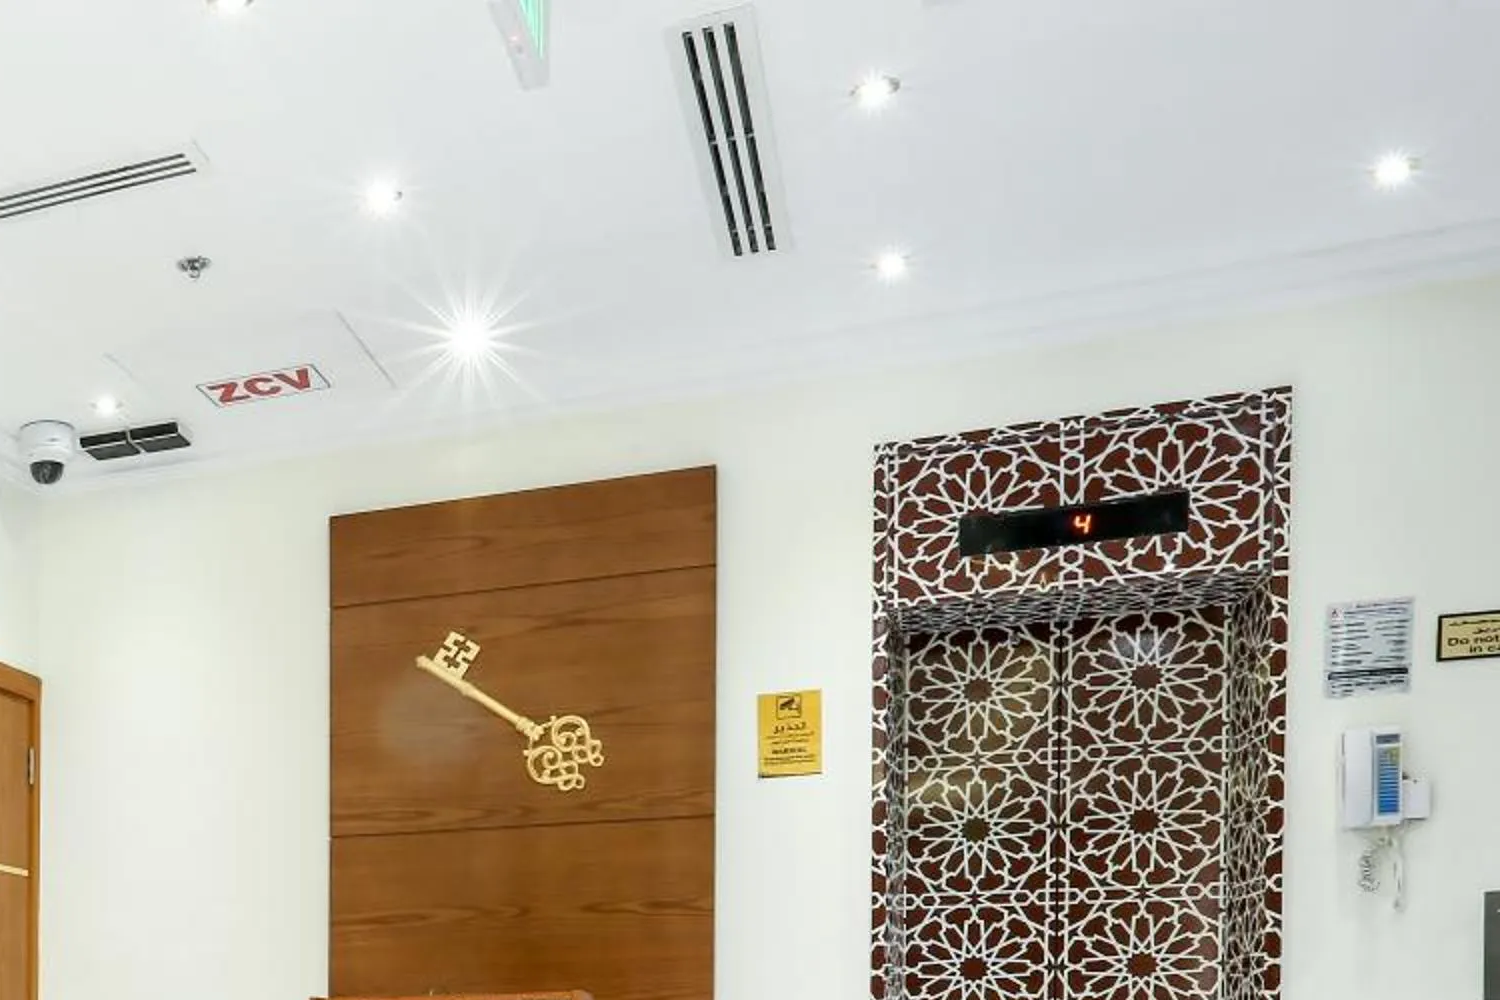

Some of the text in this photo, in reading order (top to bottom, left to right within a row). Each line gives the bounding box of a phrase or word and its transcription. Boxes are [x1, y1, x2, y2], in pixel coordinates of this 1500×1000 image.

[206, 368, 311, 402] ZCV
[1073, 513, 1092, 534] 4
[1447, 634, 1499, 647] Do not
